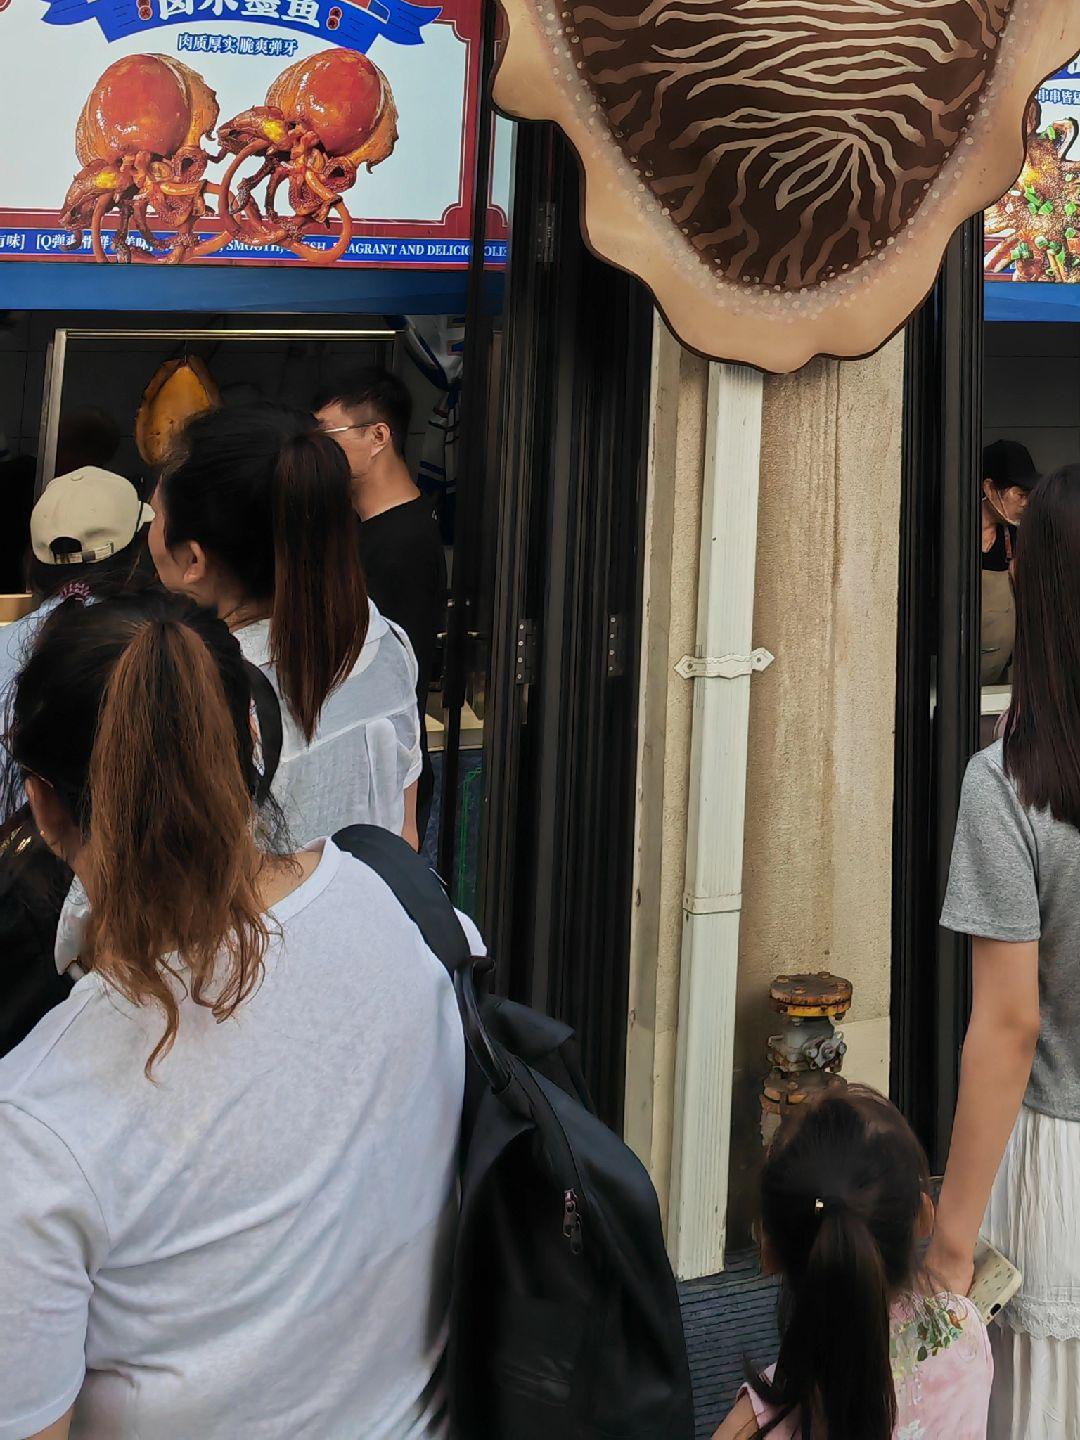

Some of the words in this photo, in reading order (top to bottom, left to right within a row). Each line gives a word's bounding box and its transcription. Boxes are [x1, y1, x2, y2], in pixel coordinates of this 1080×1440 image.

[177, 33, 238, 54] 肉质厚实
[399, 244, 425, 257] AND
